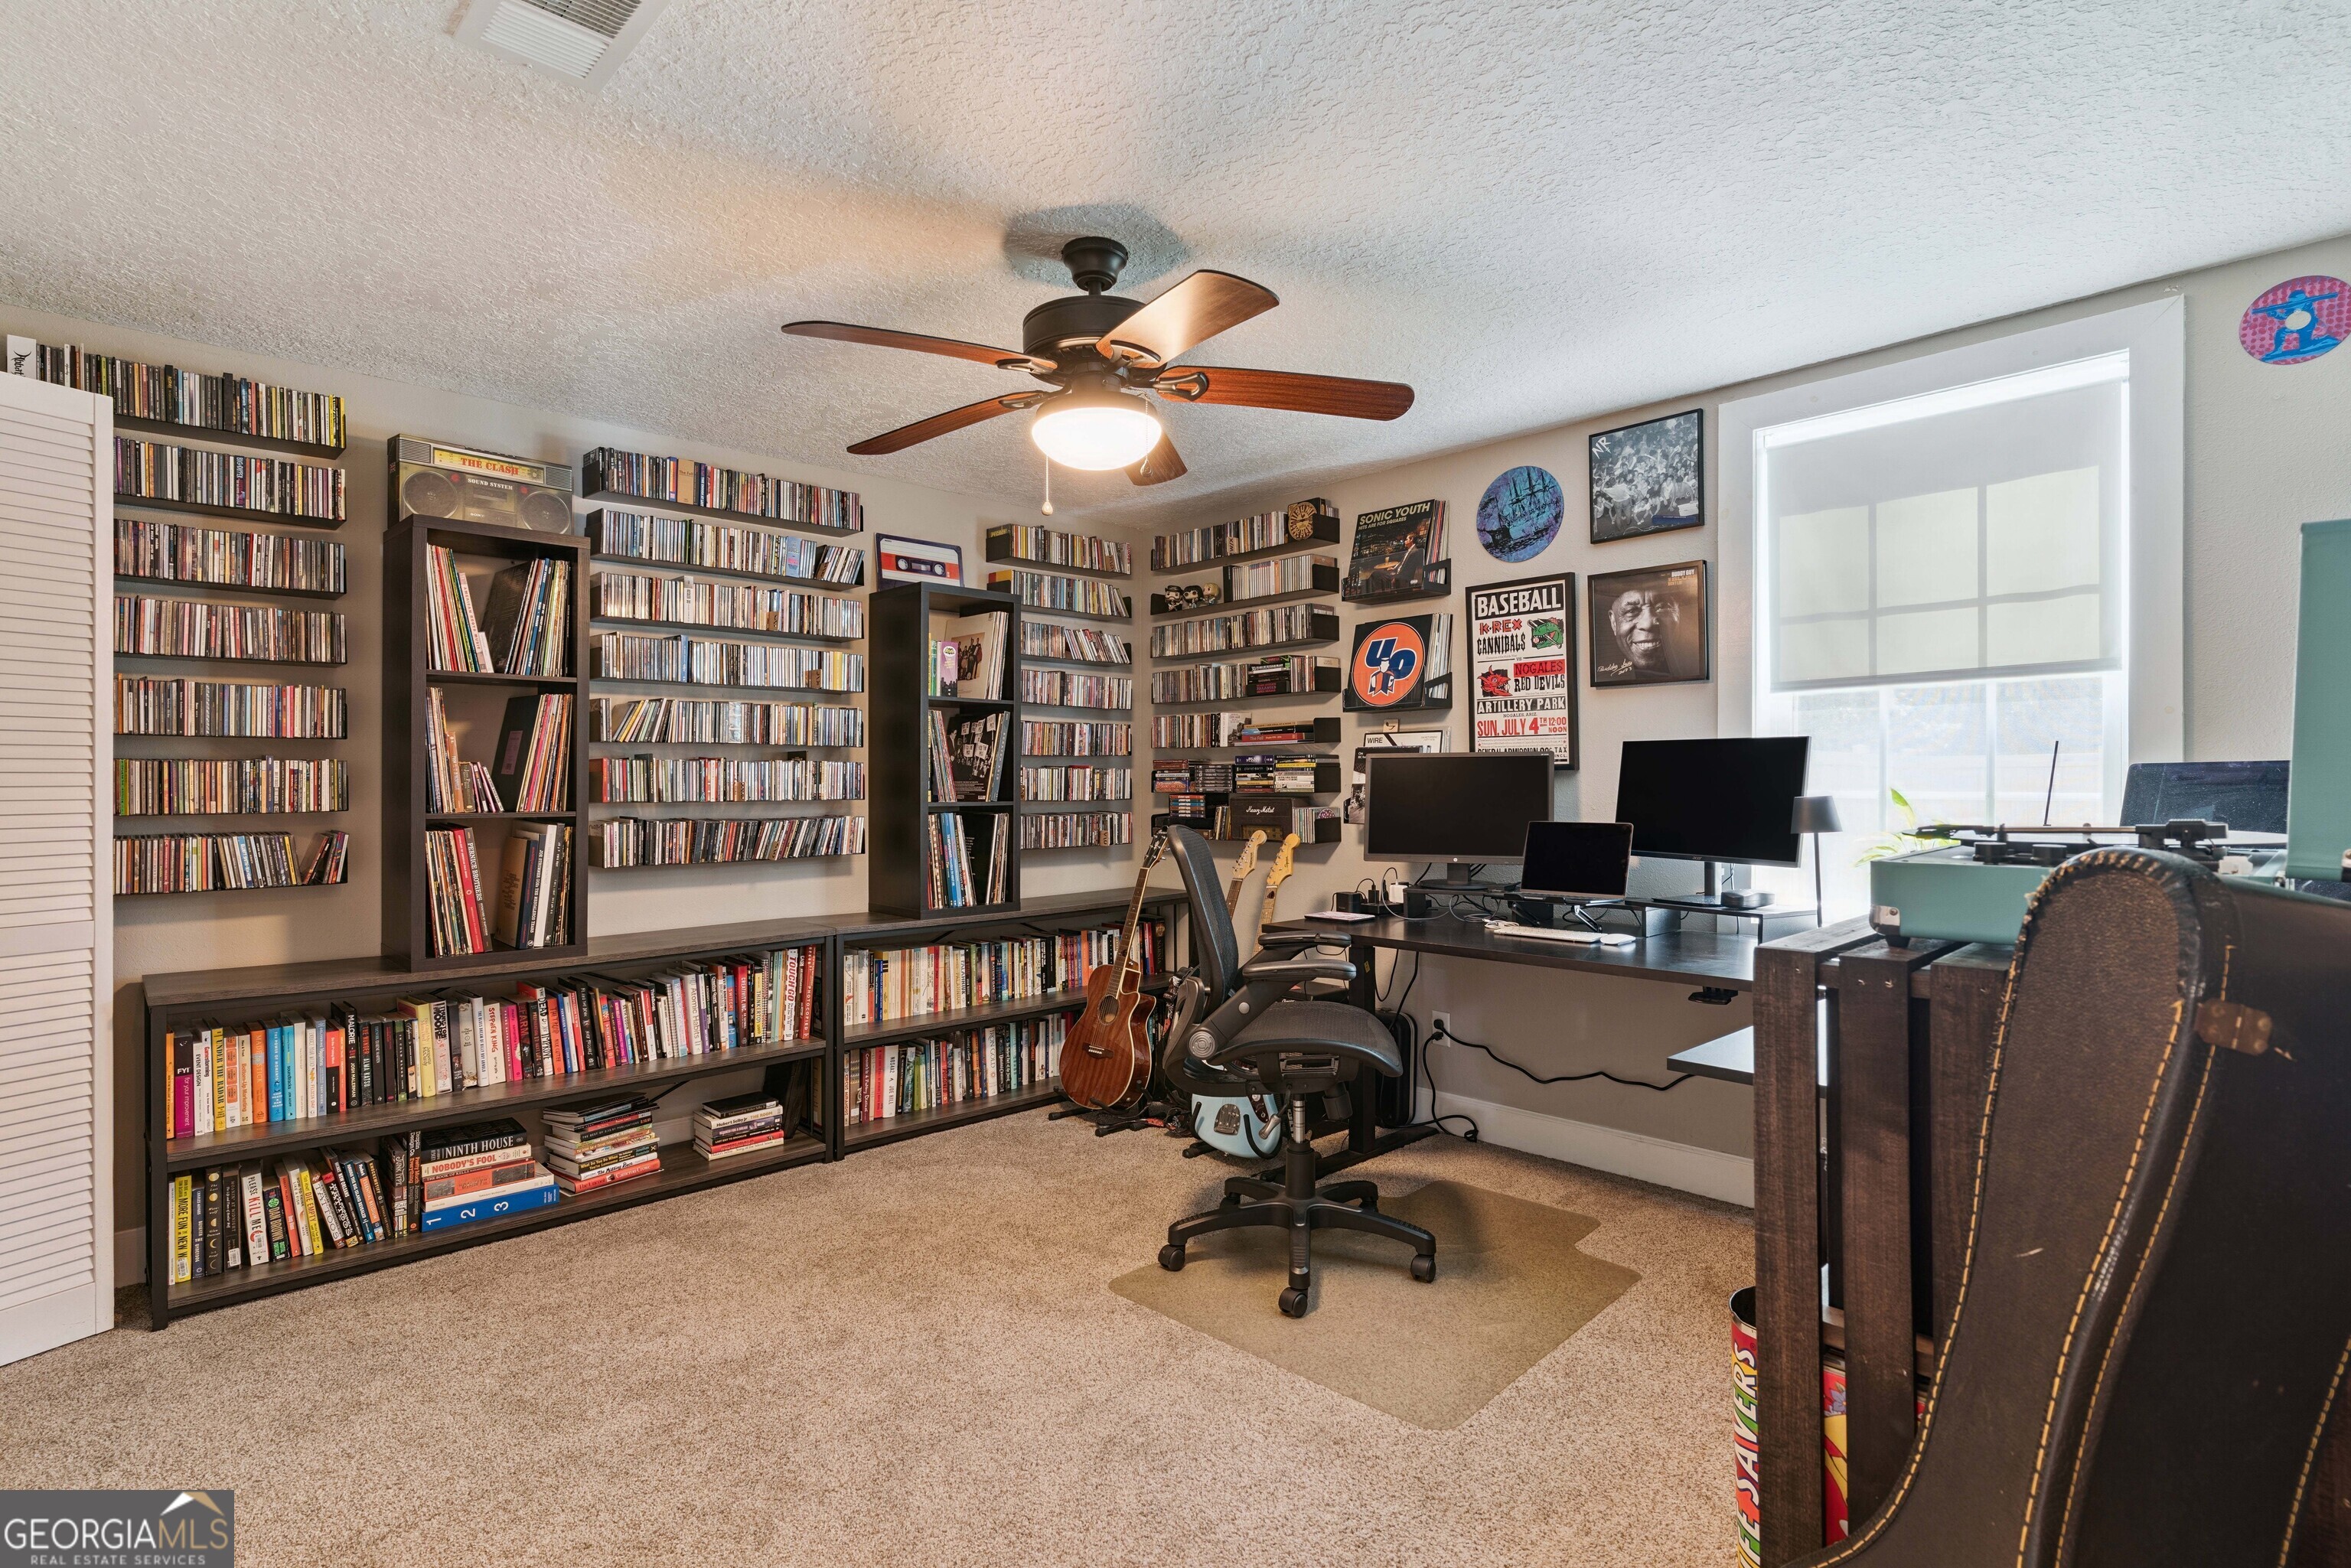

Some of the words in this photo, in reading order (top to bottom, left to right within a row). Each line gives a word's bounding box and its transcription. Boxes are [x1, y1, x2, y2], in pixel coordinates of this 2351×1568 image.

[11, 350, 31, 377] Abbat
[461, 458, 482, 468] THE
[485, 462, 520, 476] CLASH
[468, 478, 488, 486] SOUND
[490, 482, 514, 491] SYSTEM
[1359, 510, 1393, 526] SONIC
[1395, 502, 1430, 517] YOUTH
[1385, 517, 1407, 526] SQUARES
[1477, 587, 1561, 618] BASEBALL
[1477, 633, 1526, 655] CANNIBALS
[1515, 661, 1563, 675] NOGALES
[1514, 676, 1531, 693] RED
[1534, 674, 1565, 690] DEVILS
[1478, 699, 1532, 714] ARTILLERY
[1537, 696, 1565, 710] PARK
[1477, 720, 1500, 736] SUN.
[1502, 719, 1526, 735] JULY
[1529, 718, 1539, 734] 4
[1548, 717, 1567, 725] 12:00
[1246, 806, 1260, 815] Heavy
[468, 843, 478, 869] PERNICE
[472, 870, 483, 901] BROTHERS
[788, 957, 797, 988] TOUCH
[787, 989, 794, 1001] GO
[445, 1143, 478, 1158] NINTH
[481, 1136, 514, 1150] HOUSE
[432, 1158, 474, 1174] NOBODY'S
[476, 1154, 497, 1165] FOOL
[248, 1176, 258, 1195] PLEASE
[369, 1162, 380, 1194] KNOCKEMSTIFF
[341, 1182, 349, 1197] ORLEANS
[178, 1198, 188, 1216] MORE
[269, 1208, 281, 1221] DAN
[307, 1204, 316, 1221] EMPTY
[315, 1184, 339, 1240] TATTOOS
[329, 1184, 351, 1237] TATTOOS
[461, 1208, 475, 1219] 2
[494, 1201, 509, 1211] 3
[178, 1217, 188, 1230] FUN
[251, 1219, 261, 1231] ME
[270, 1218, 284, 1241] BROWN
[178, 1236, 188, 1250] NEW
[1733, 1341, 1760, 1505] SAVERS
